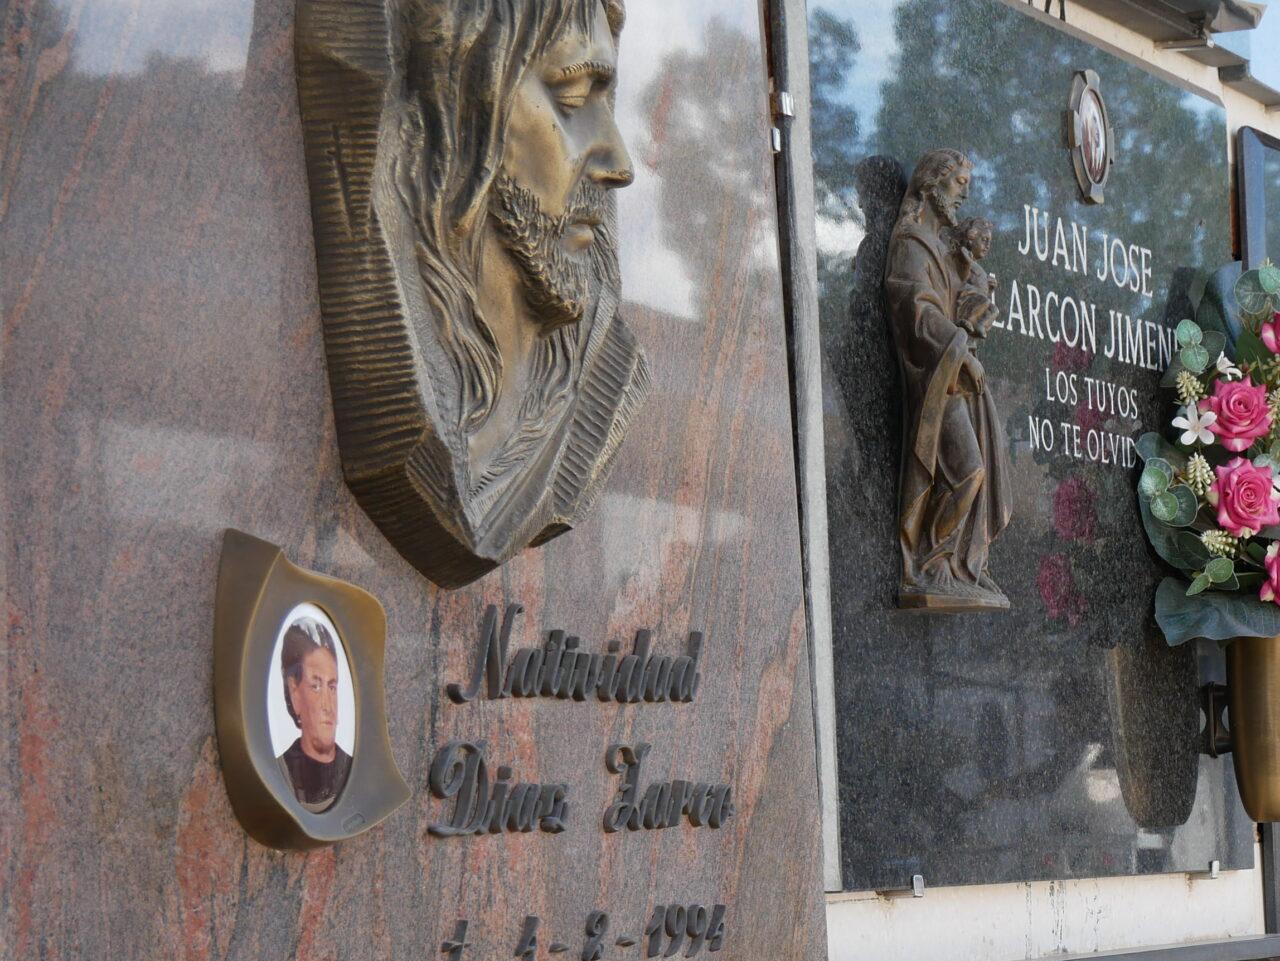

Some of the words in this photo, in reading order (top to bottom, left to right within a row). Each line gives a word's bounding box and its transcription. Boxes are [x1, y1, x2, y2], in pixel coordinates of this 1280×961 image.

[1018, 203, 1088, 277] JUAN
[1096, 233, 1154, 298] JOSE
[1028, 415, 1054, 452] NO
[1060, 422, 1082, 458] TE
[1045, 367, 1078, 406] LOS
[1084, 376, 1139, 420] TUYOS
[447, 603, 702, 704] Natividad
[427, 739, 569, 838] Diaz
